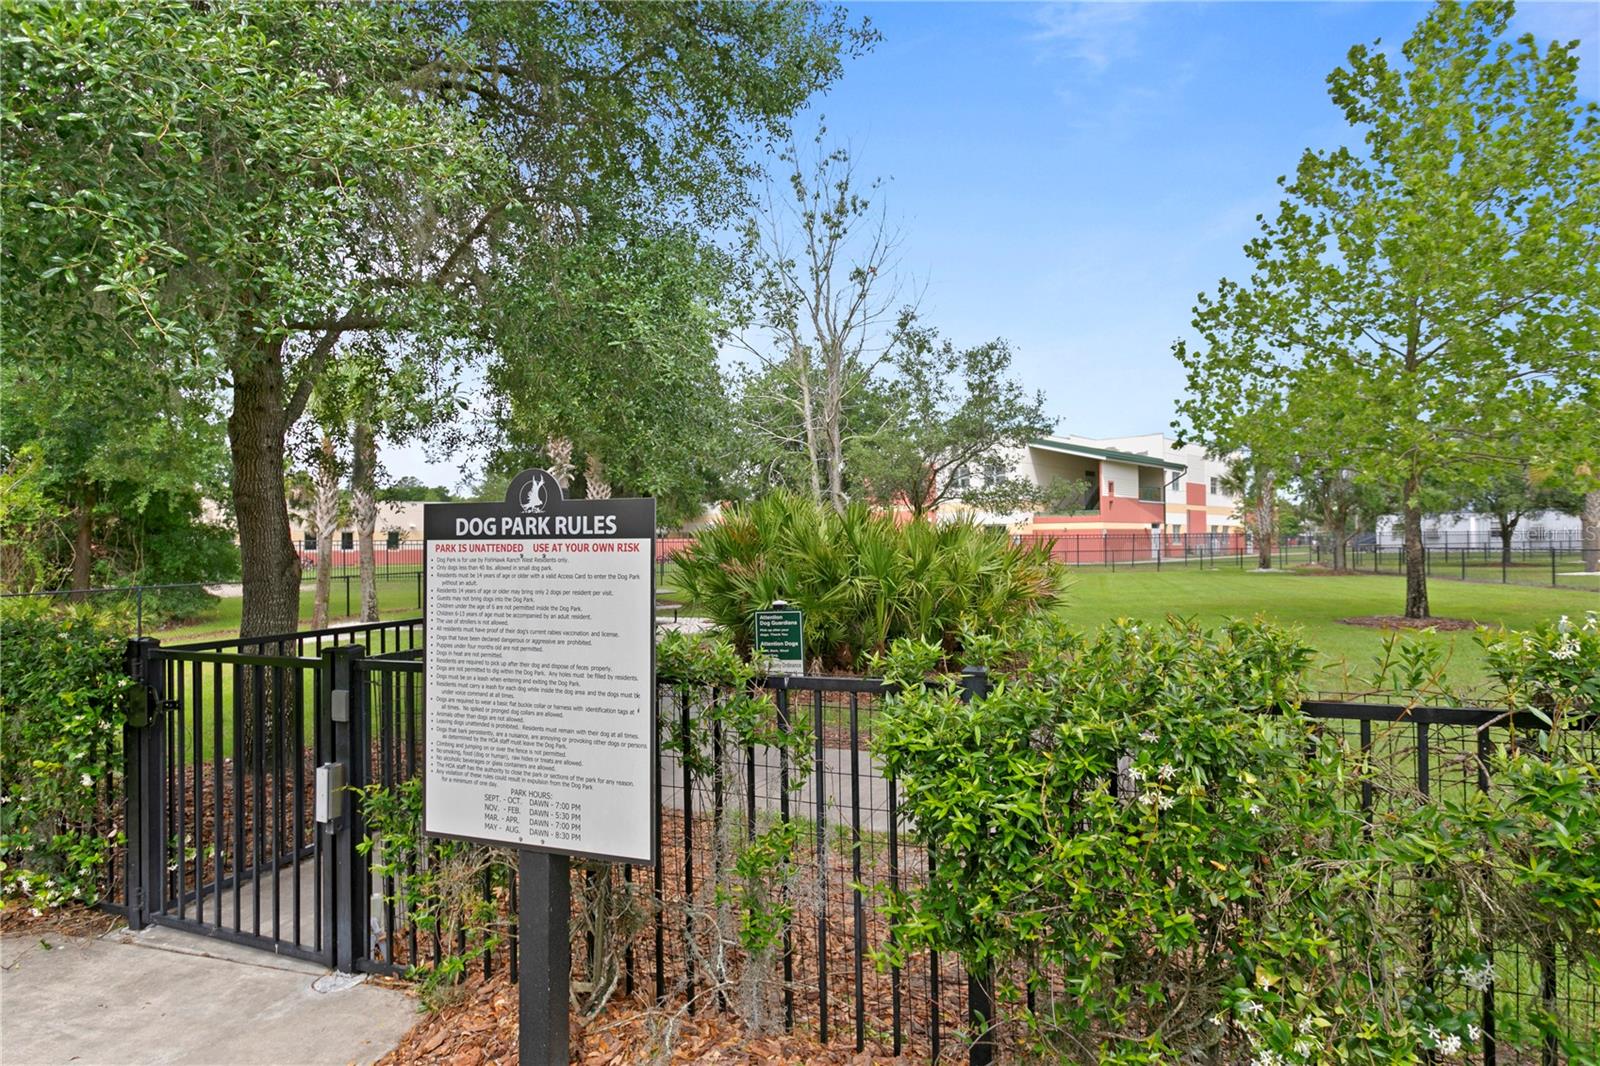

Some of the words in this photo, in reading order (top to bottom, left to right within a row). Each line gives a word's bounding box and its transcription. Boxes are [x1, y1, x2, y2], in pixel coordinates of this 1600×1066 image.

[456, 517, 496, 536] DOG
[502, 516, 550, 536] PARK
[555, 515, 617, 535] RULES
[435, 544, 456, 553] PARK
[458, 544, 467, 552] IS
[469, 544, 524, 552] UNATTENDED
[533, 543, 549, 552] USE
[552, 543, 564, 552] AT
[566, 543, 589, 552] YOUR
[592, 543, 615, 552] OWN
[618, 543, 640, 552] RISK
[528, 790, 553, 799] HOURS:
[529, 799, 549, 808] DAWN
[529, 809, 550, 817] DAWN
[555, 812, 570, 820] 5:30
[529, 818, 549, 827] DAWN
[556, 822, 570, 830] 7:00
[529, 828, 549, 837] DAWN
[555, 831, 570, 840] 8:30
